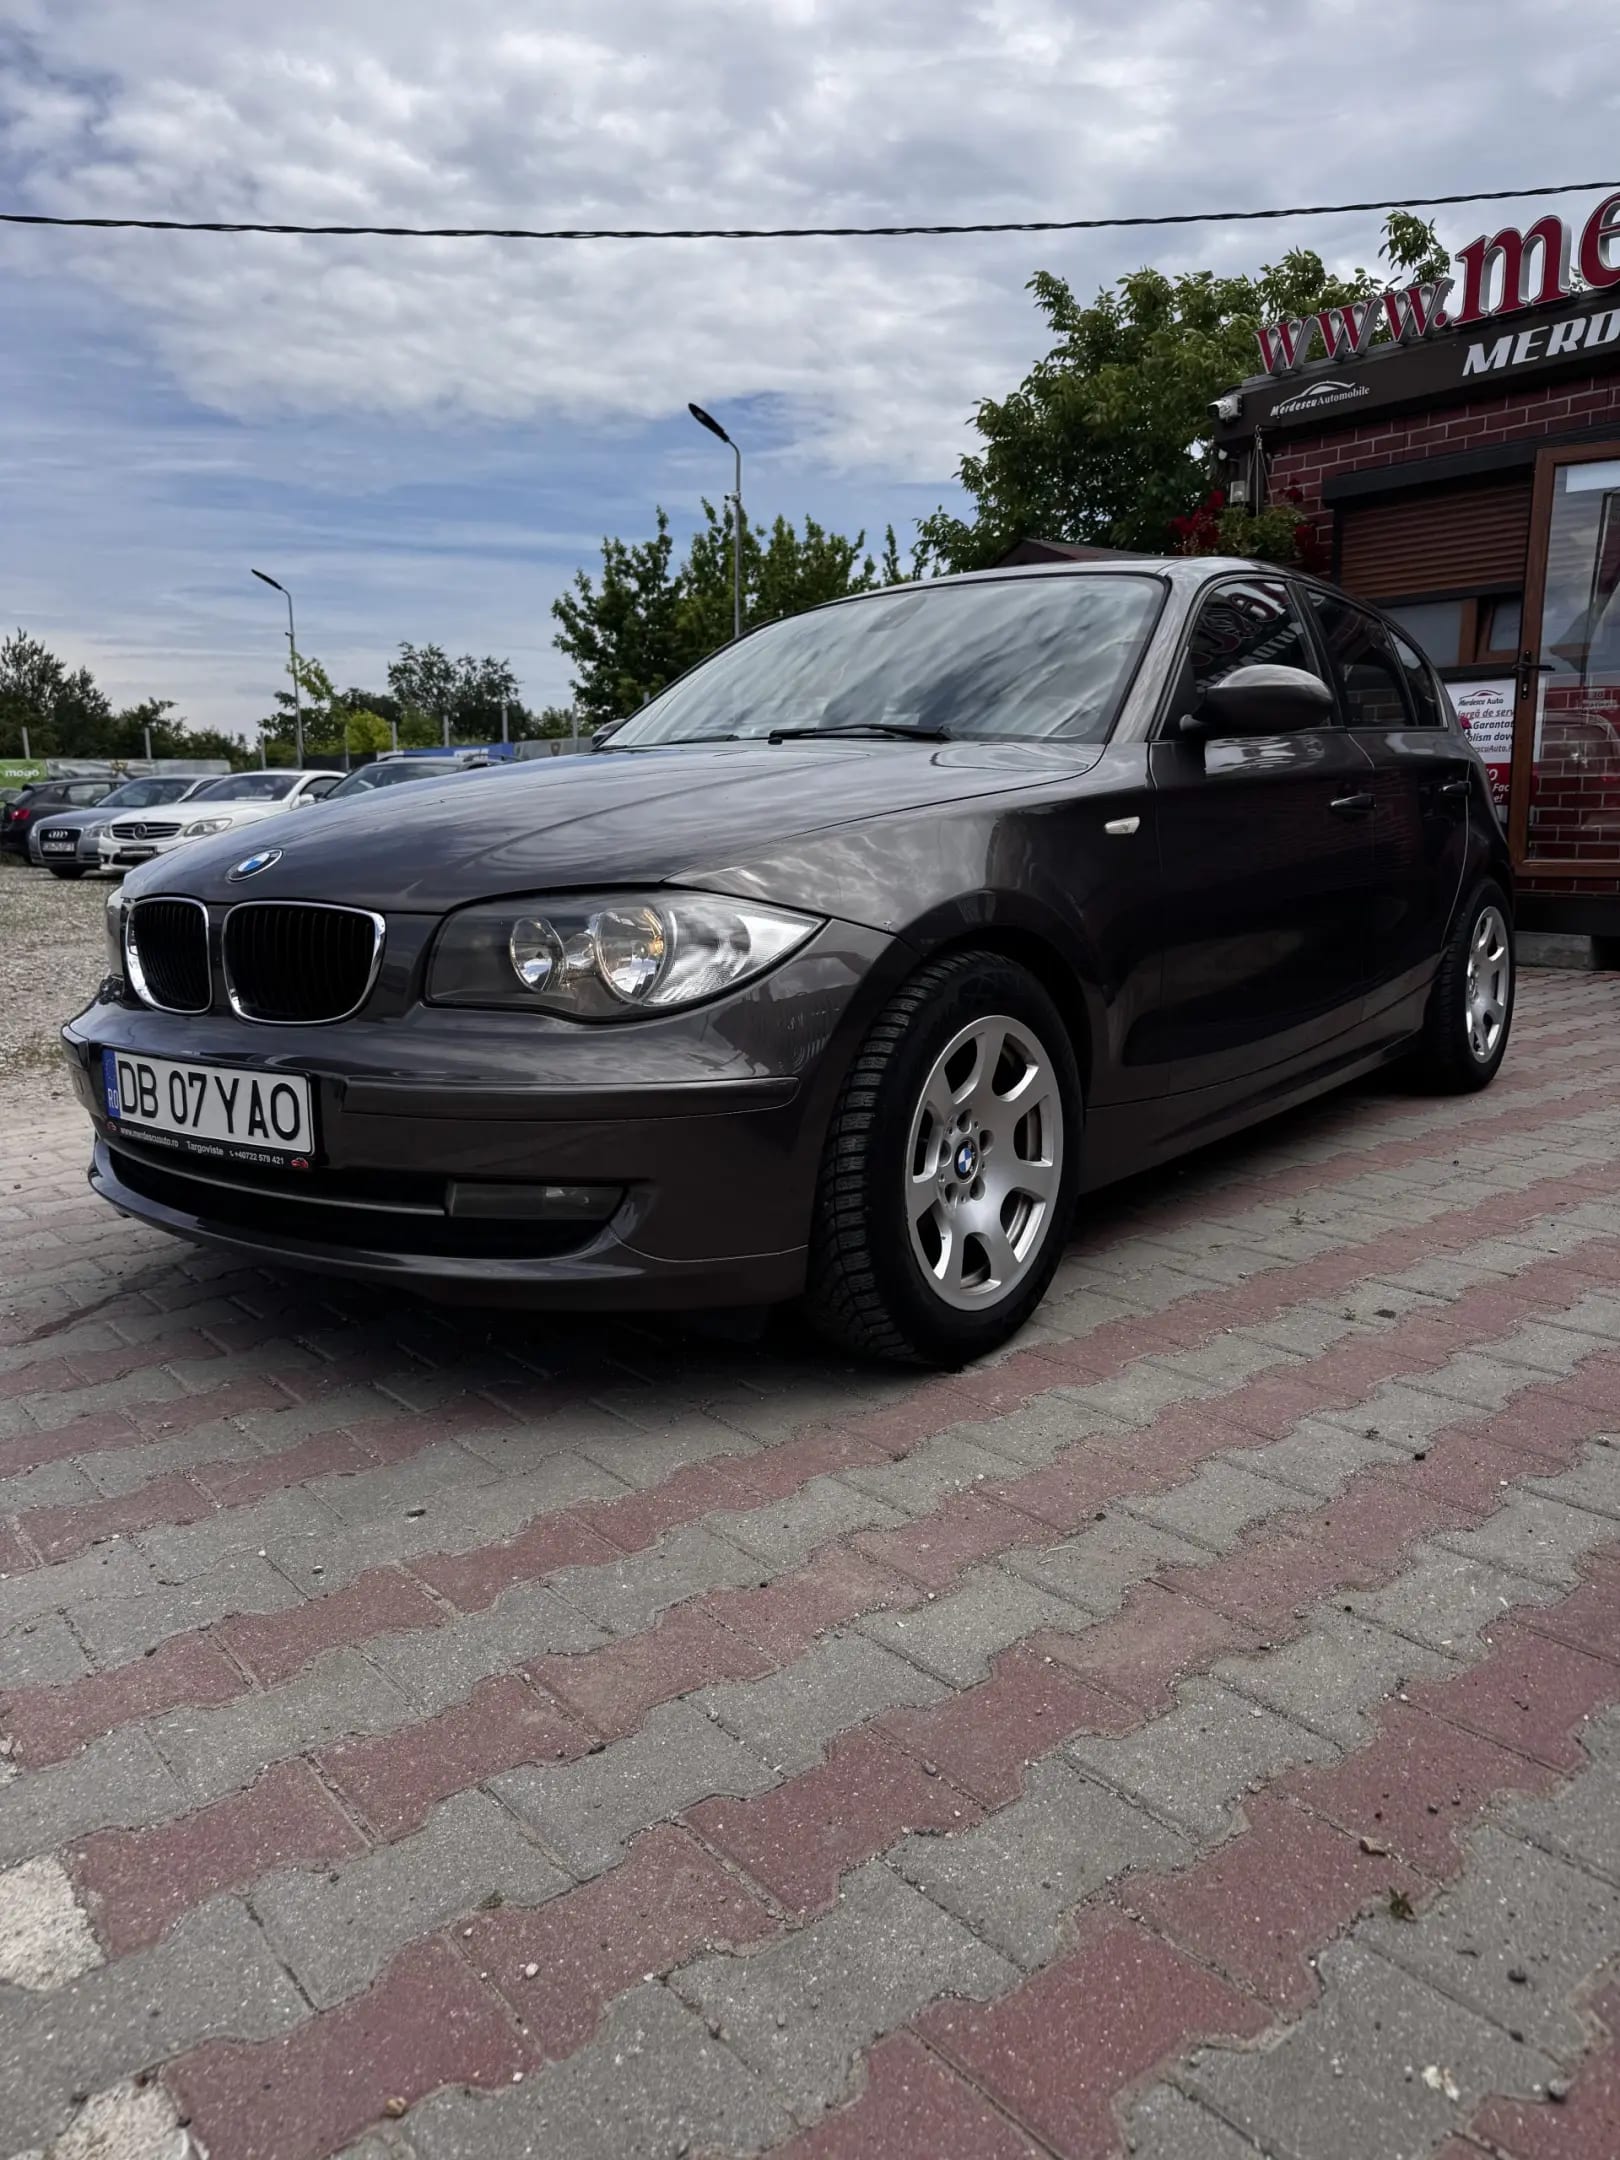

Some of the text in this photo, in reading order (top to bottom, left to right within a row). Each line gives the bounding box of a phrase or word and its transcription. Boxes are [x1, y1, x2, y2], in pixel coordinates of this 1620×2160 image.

[1482, 708, 1494, 718] de
[107, 1088, 119, 1111] RO
[118, 1060, 301, 1141] DB 07 YAO
[185, 1140, 225, 1156] Targoviste
[271, 1155, 285, 1165] 421
